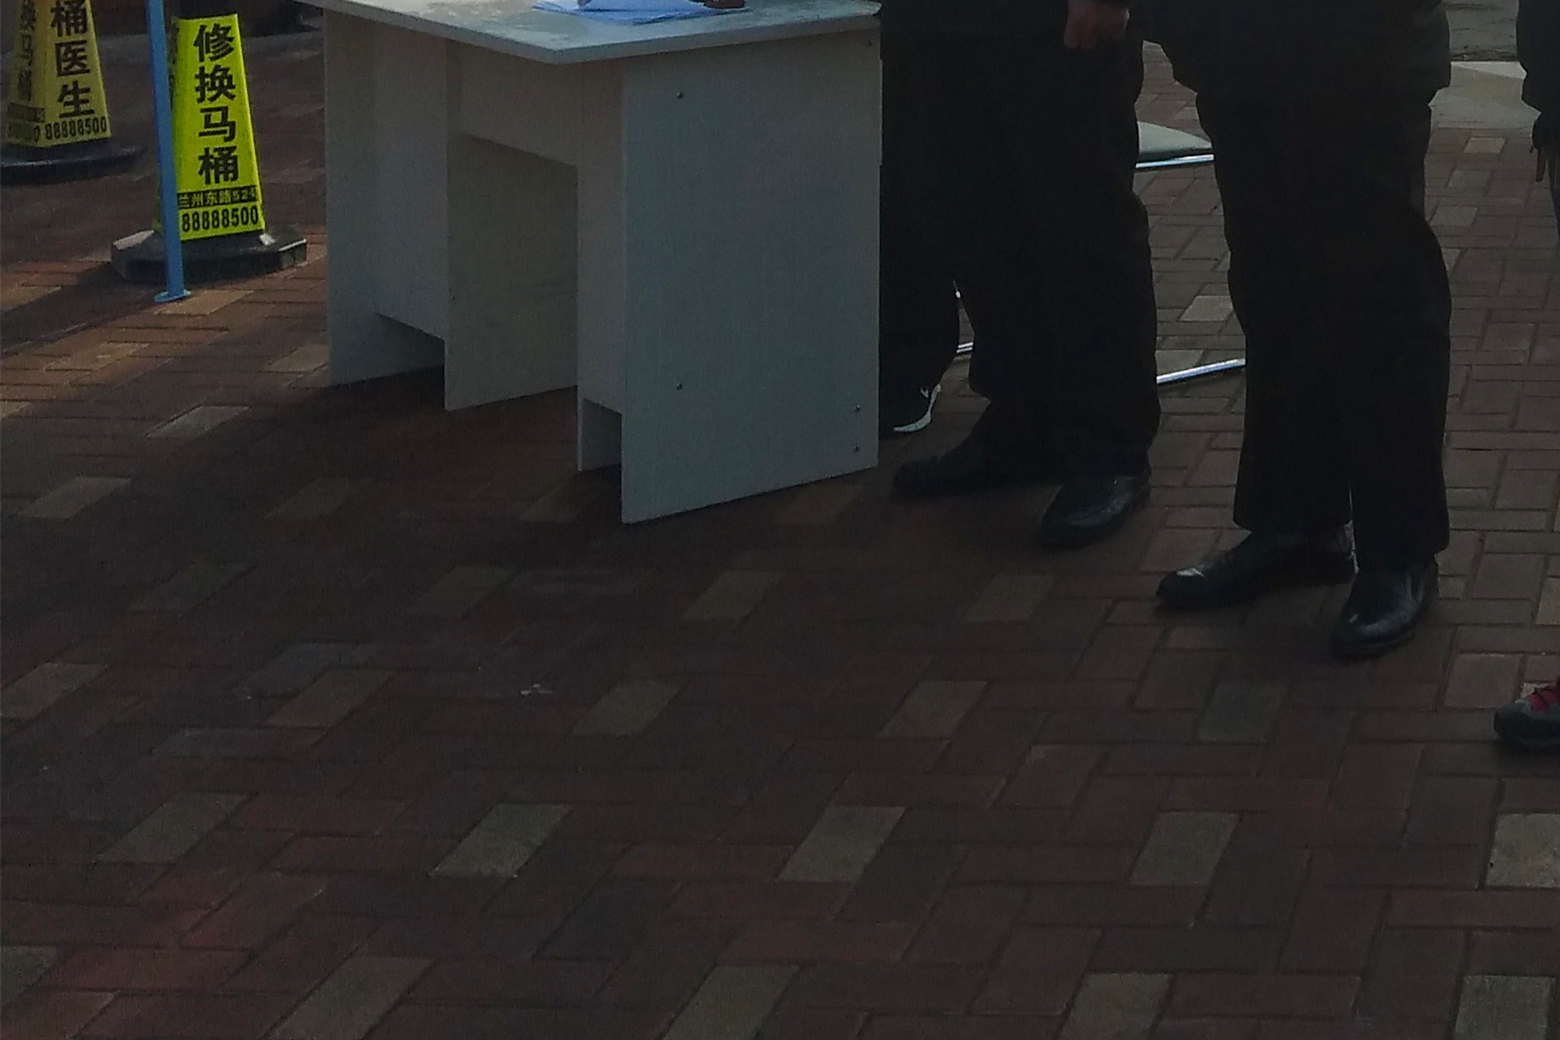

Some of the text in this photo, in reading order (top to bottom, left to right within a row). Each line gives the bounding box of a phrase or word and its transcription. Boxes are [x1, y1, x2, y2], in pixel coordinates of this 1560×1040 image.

[192, 22, 239, 185] 修换马桶
[182, 205, 259, 232] 88888500
